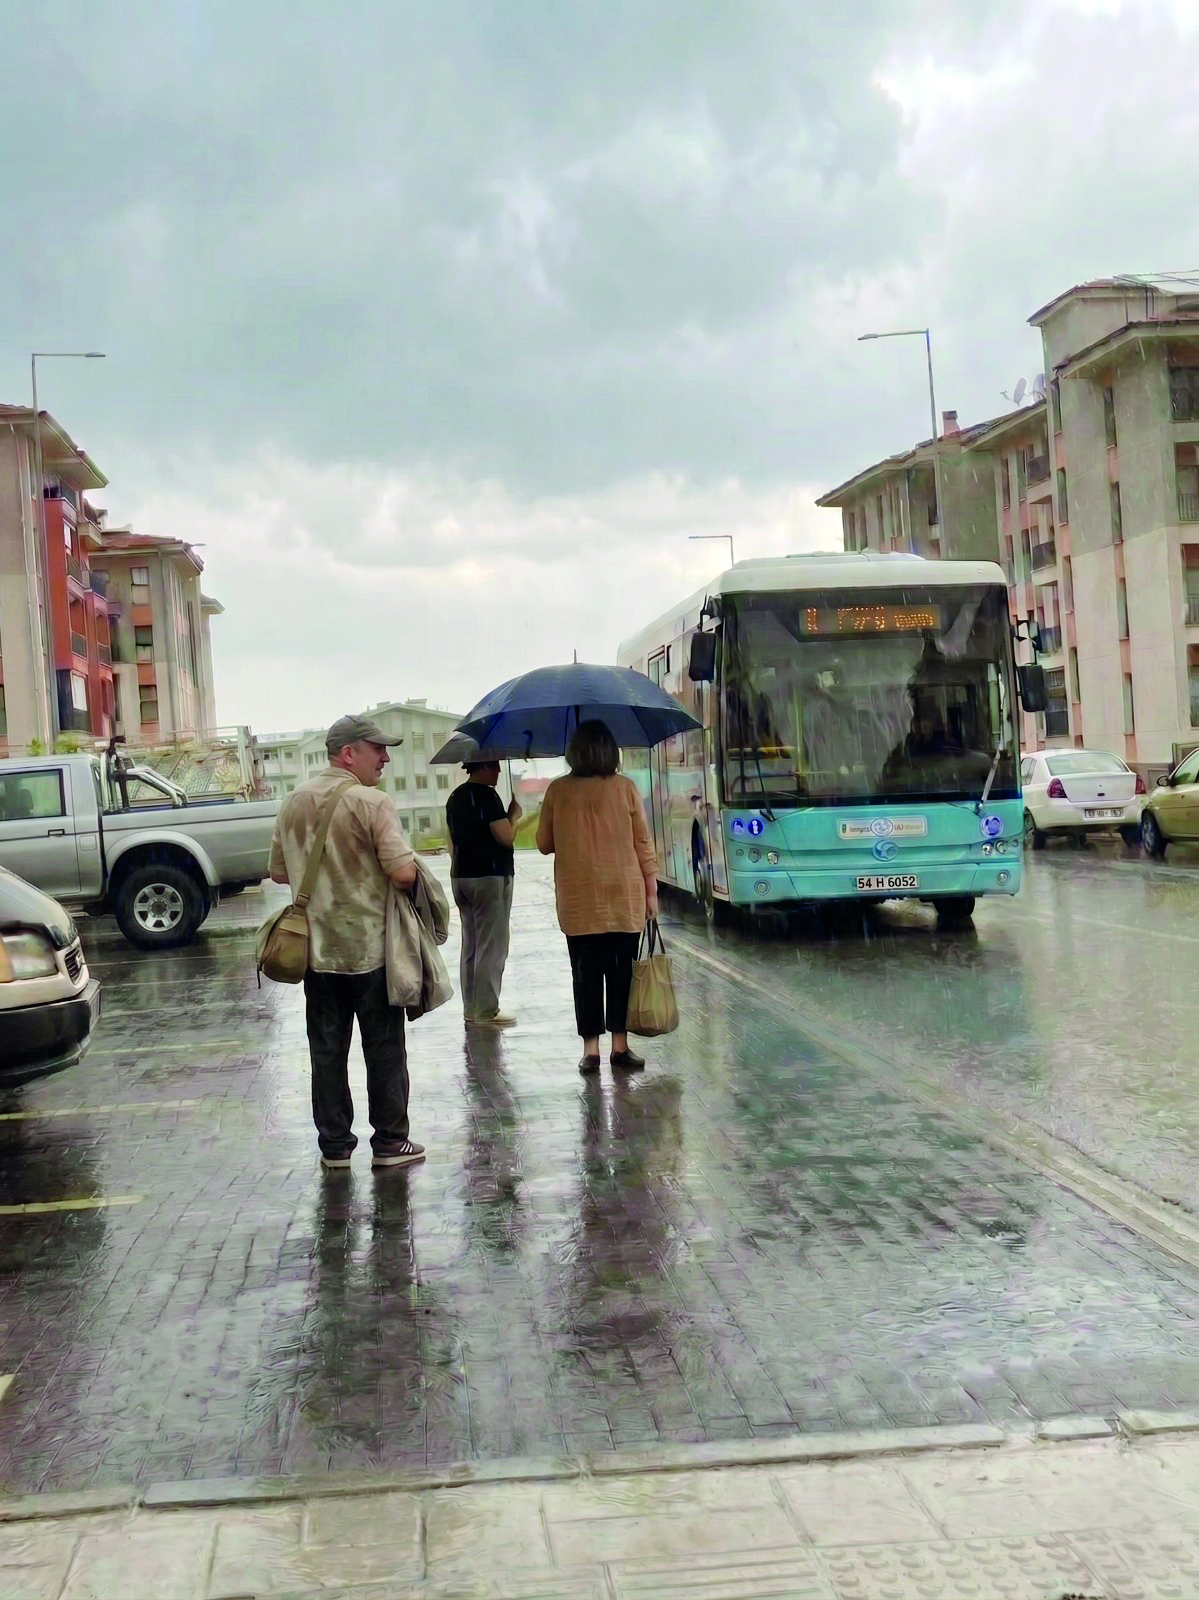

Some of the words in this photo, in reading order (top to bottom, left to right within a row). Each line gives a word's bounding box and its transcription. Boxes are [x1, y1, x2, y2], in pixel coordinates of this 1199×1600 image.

[858, 878, 872, 888] 54
[876, 877, 884, 888] H
[888, 876, 916, 887] 6052
